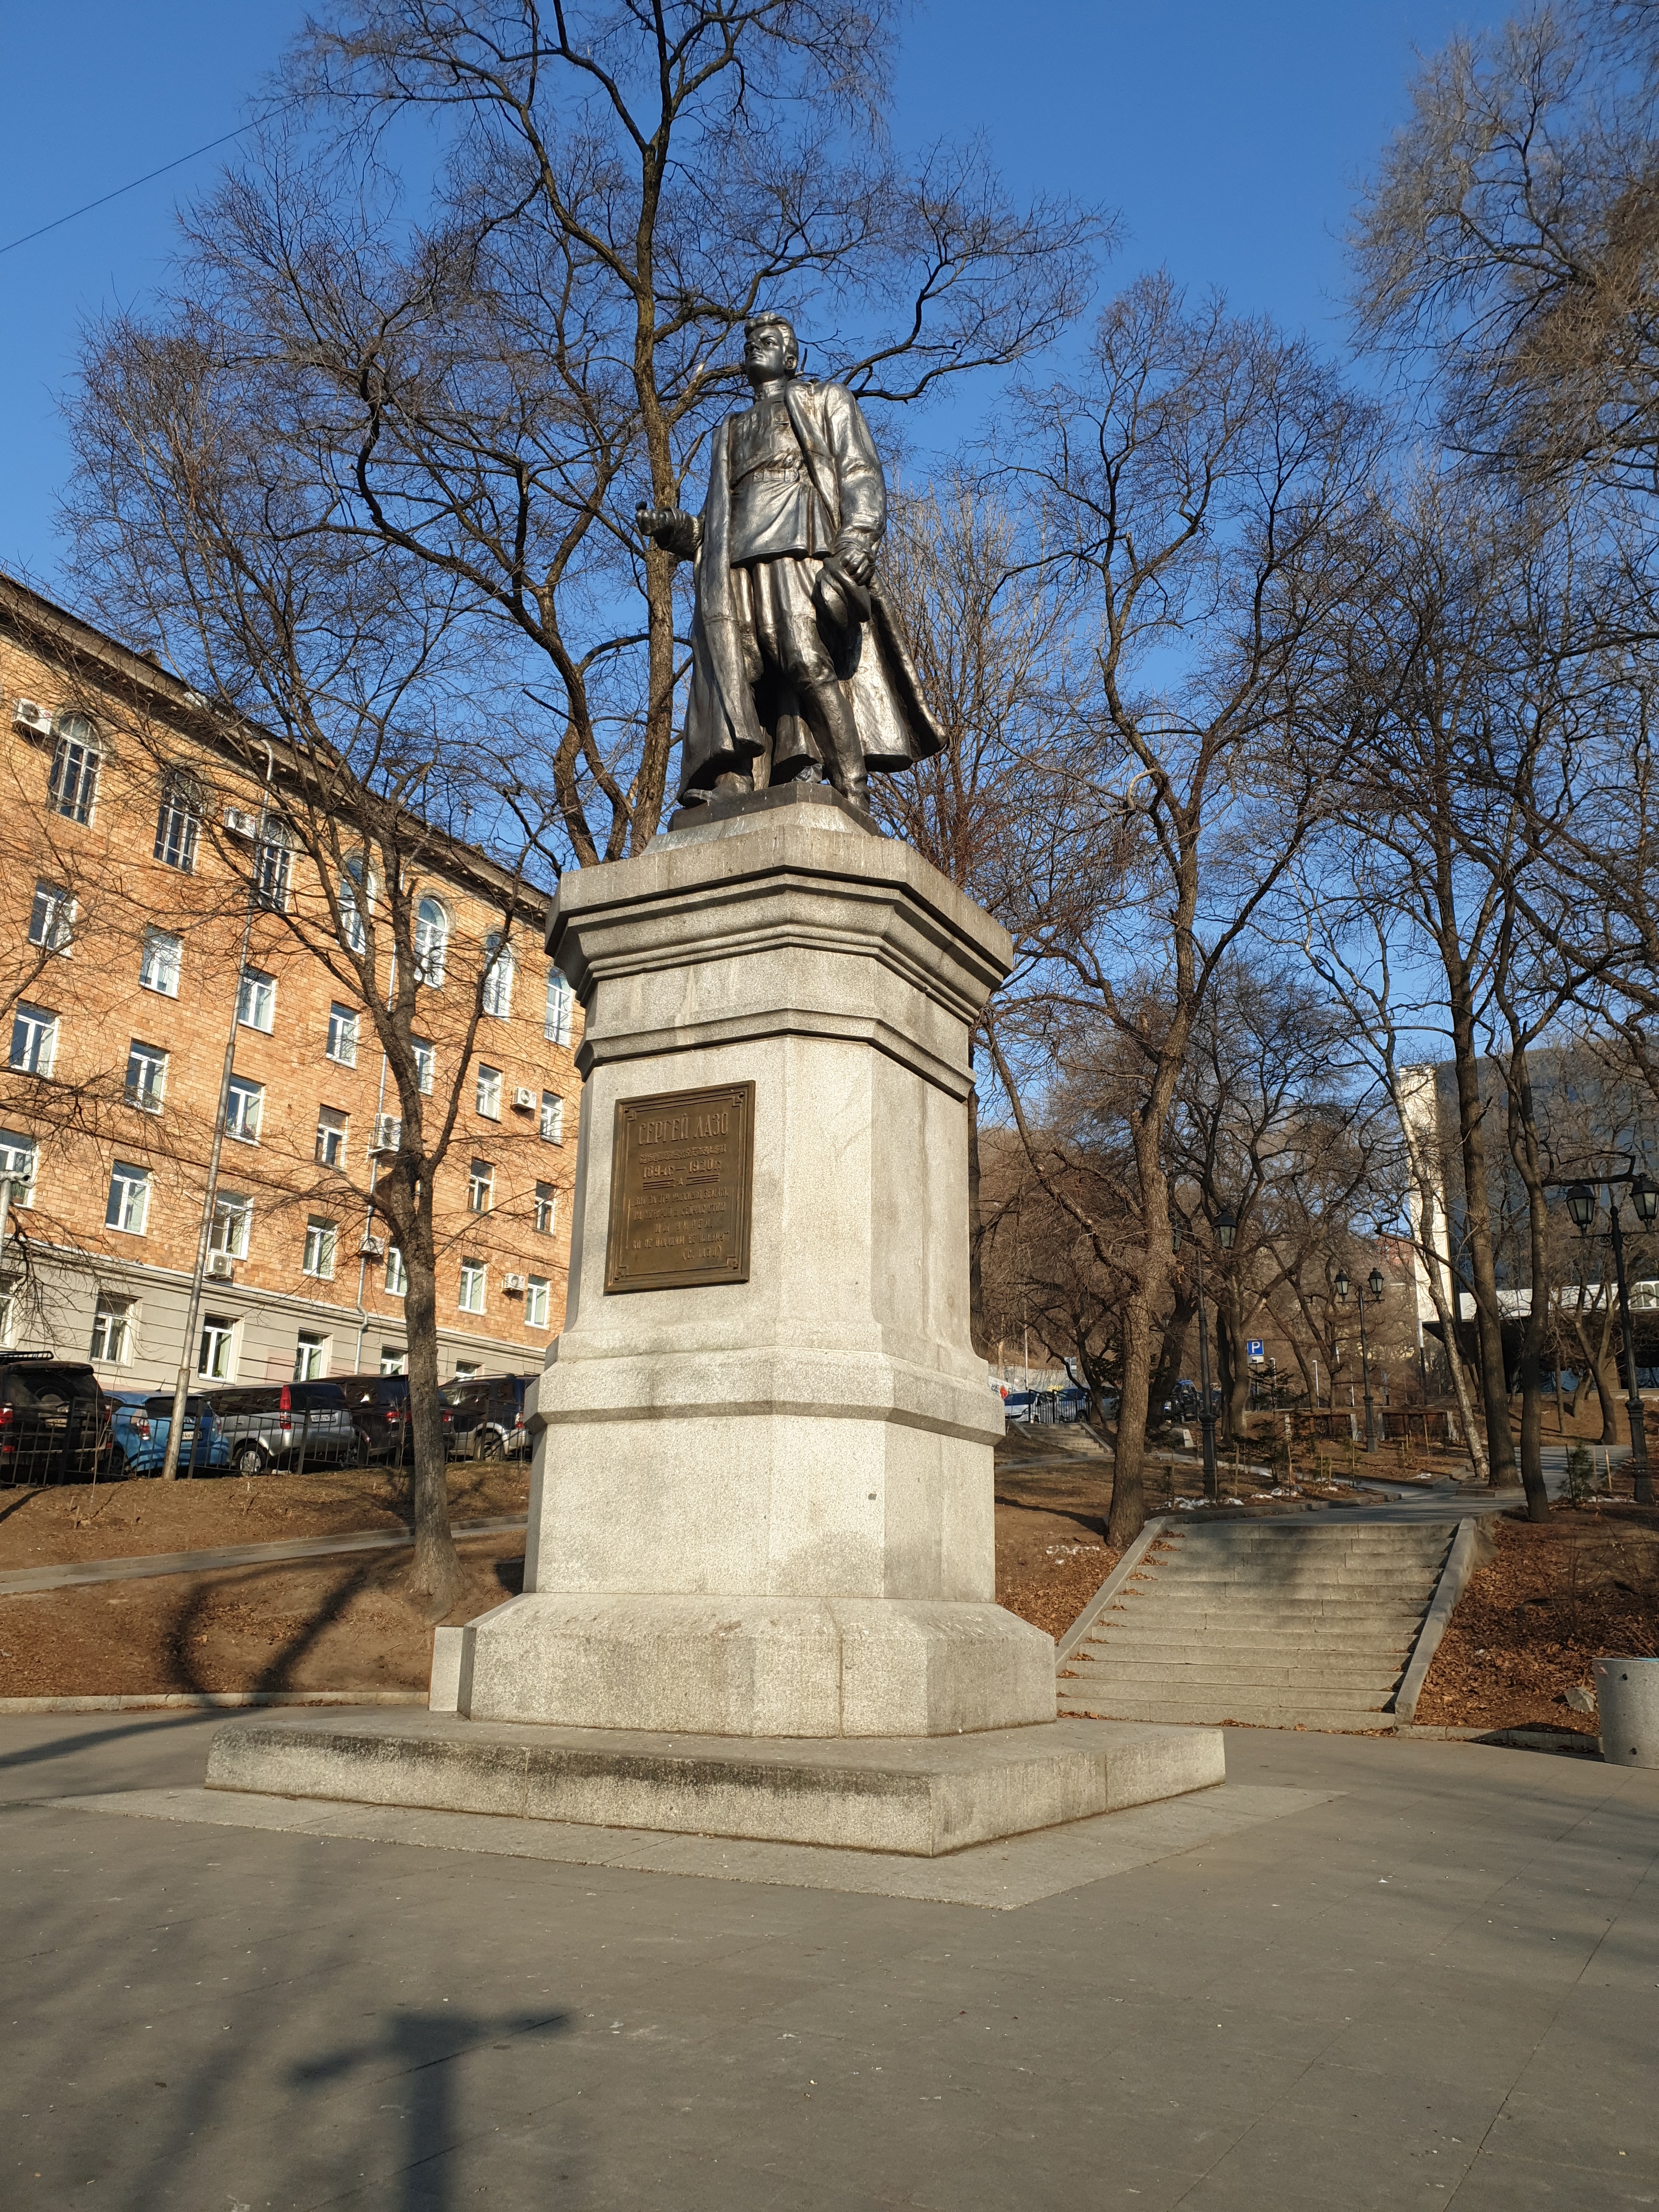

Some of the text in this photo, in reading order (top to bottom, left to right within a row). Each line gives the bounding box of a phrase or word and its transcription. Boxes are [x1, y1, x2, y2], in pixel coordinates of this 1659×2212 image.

[638, 1112, 729, 1146] СЕРГЕЙ ЛАЗО
[1251, 1341, 1261, 1354] P
